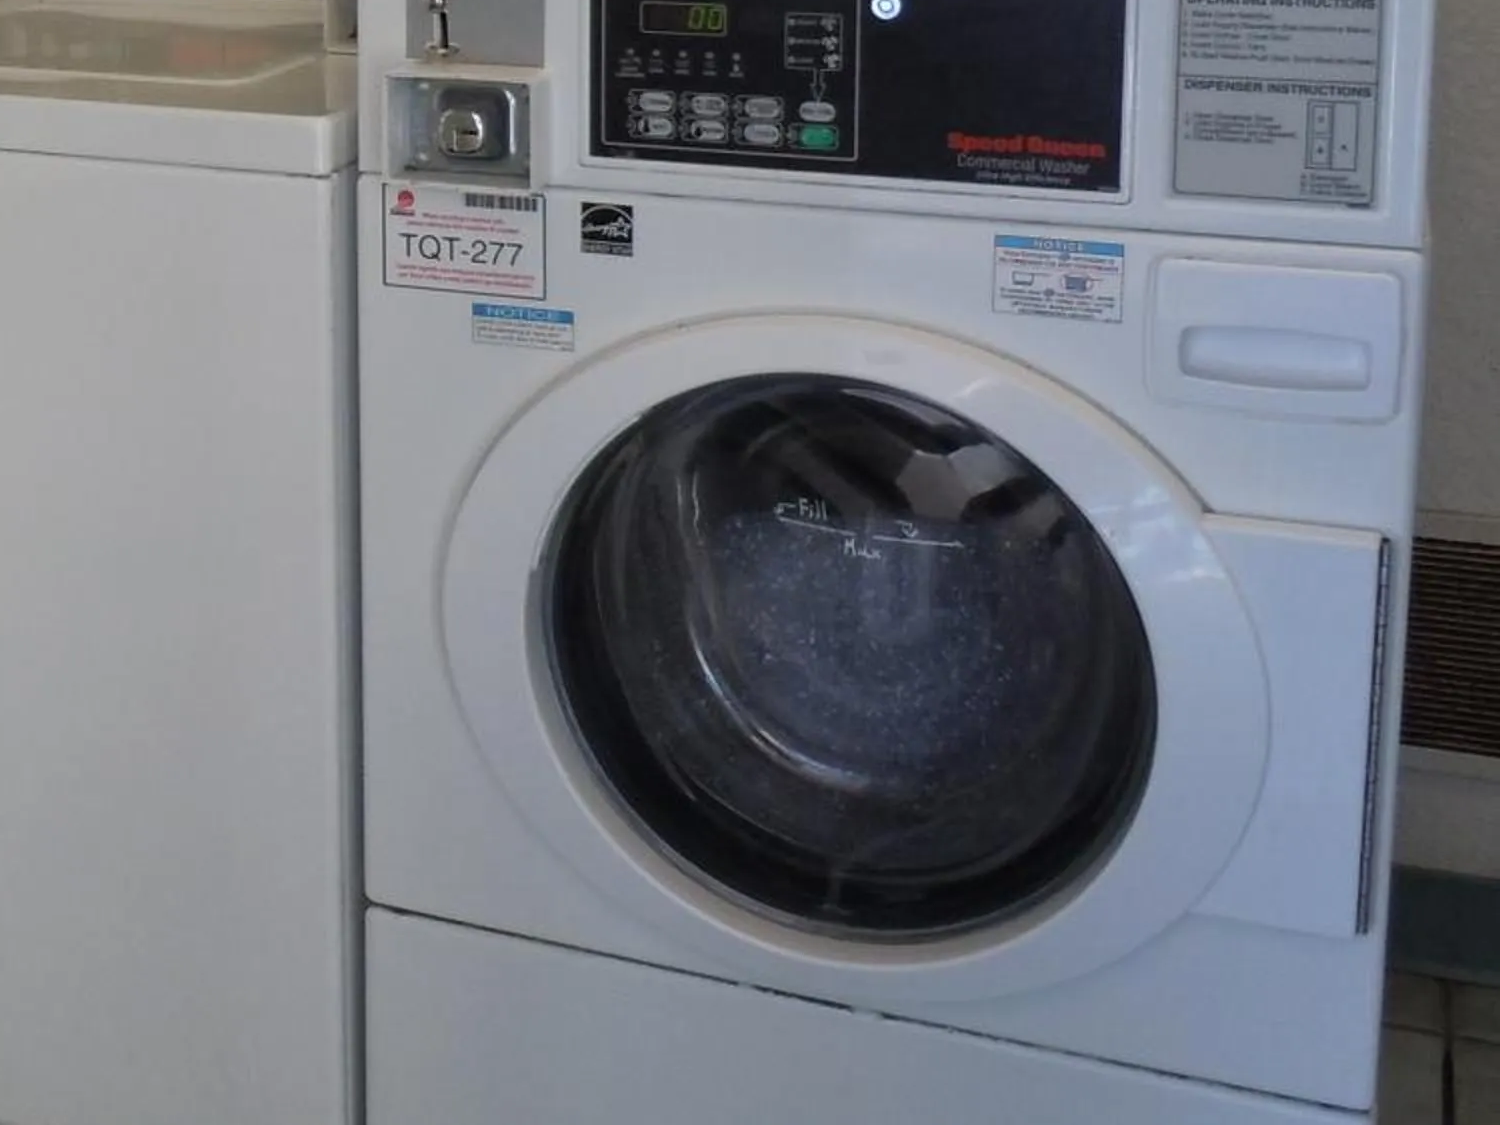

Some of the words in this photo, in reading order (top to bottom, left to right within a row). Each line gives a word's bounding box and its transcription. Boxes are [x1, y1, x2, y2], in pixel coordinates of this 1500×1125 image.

[1183, 78, 1263, 93] DISPENSER
[1266, 82, 1372, 98] INSTRUCTIONS
[398, 232, 525, 267] TQT-277
